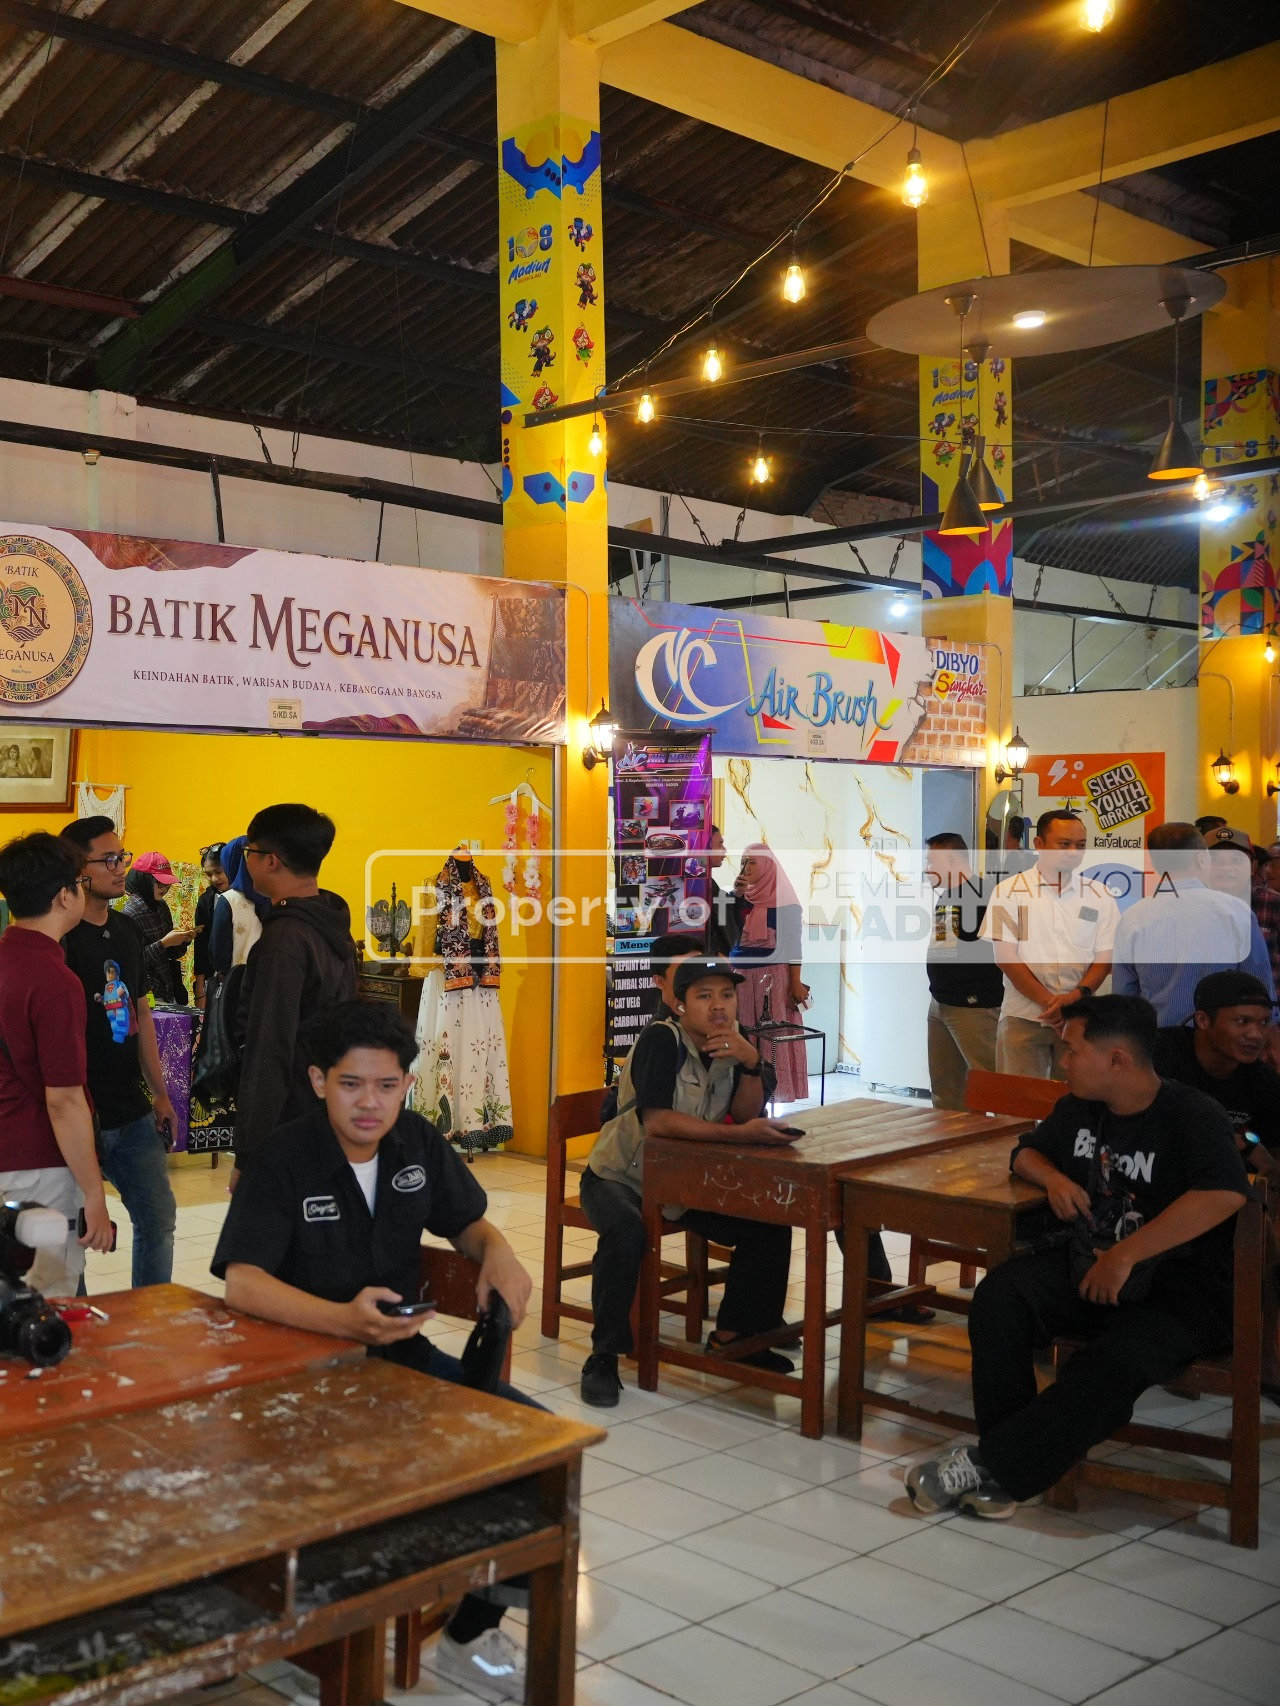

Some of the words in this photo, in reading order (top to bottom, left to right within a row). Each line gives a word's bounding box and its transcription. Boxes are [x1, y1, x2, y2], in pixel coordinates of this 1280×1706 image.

[508, 257, 551, 285] Madiun
[932, 387, 976, 407] Madiun
[5, 565, 39, 578] BATIK
[107, 593, 238, 643] BATIK
[248, 593, 482, 668] MEGANUSA
[936, 650, 979, 675] DIBYO
[133, 669, 199, 684] KEINDAHAN
[202, 674, 234, 686] BATIK
[242, 676, 290, 689] WARISAN
[292, 679, 332, 692] BUDAYA
[339, 682, 404, 698] KEBANGGAAN
[407, 688, 443, 700] BANGSA
[935, 672, 987, 703] Sangkar
[1087, 764, 1136, 797] SLEKO
[1089, 781, 1145, 814] YOUTH
[1098, 796, 1151, 829] MARKET
[615, 959, 639, 972] REPAINT
[614, 978, 638, 991] TAMBAL
[638, 977, 655, 990] SULA
[614, 997, 626, 1010] CAT
[626, 996, 641, 1008] VELG
[613, 1015, 639, 1028] CARBON
